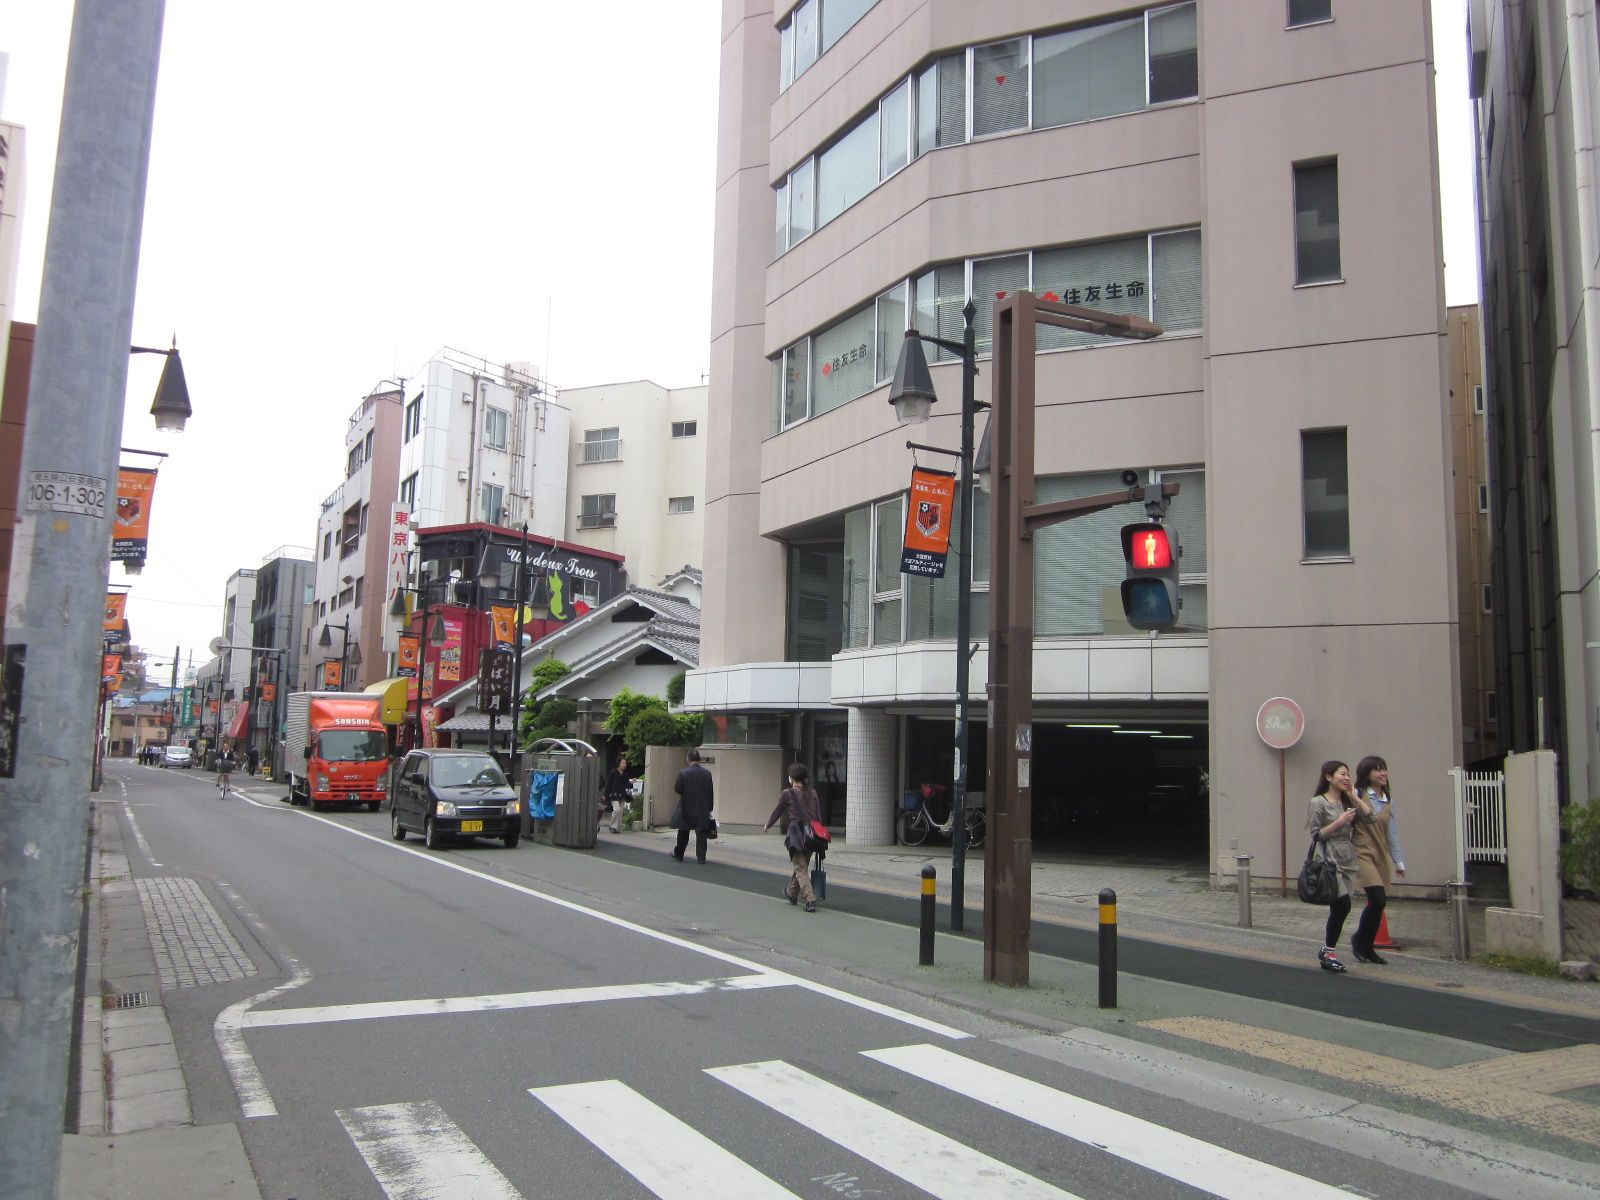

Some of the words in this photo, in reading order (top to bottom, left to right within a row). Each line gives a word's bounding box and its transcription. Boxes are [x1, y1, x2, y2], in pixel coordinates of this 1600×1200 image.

[1063, 281, 1145, 304] 住友生命
[832, 343, 867, 372] 住友生命
[564, 558, 597, 578] Trois
[335, 718, 370, 726] SANSHIN
